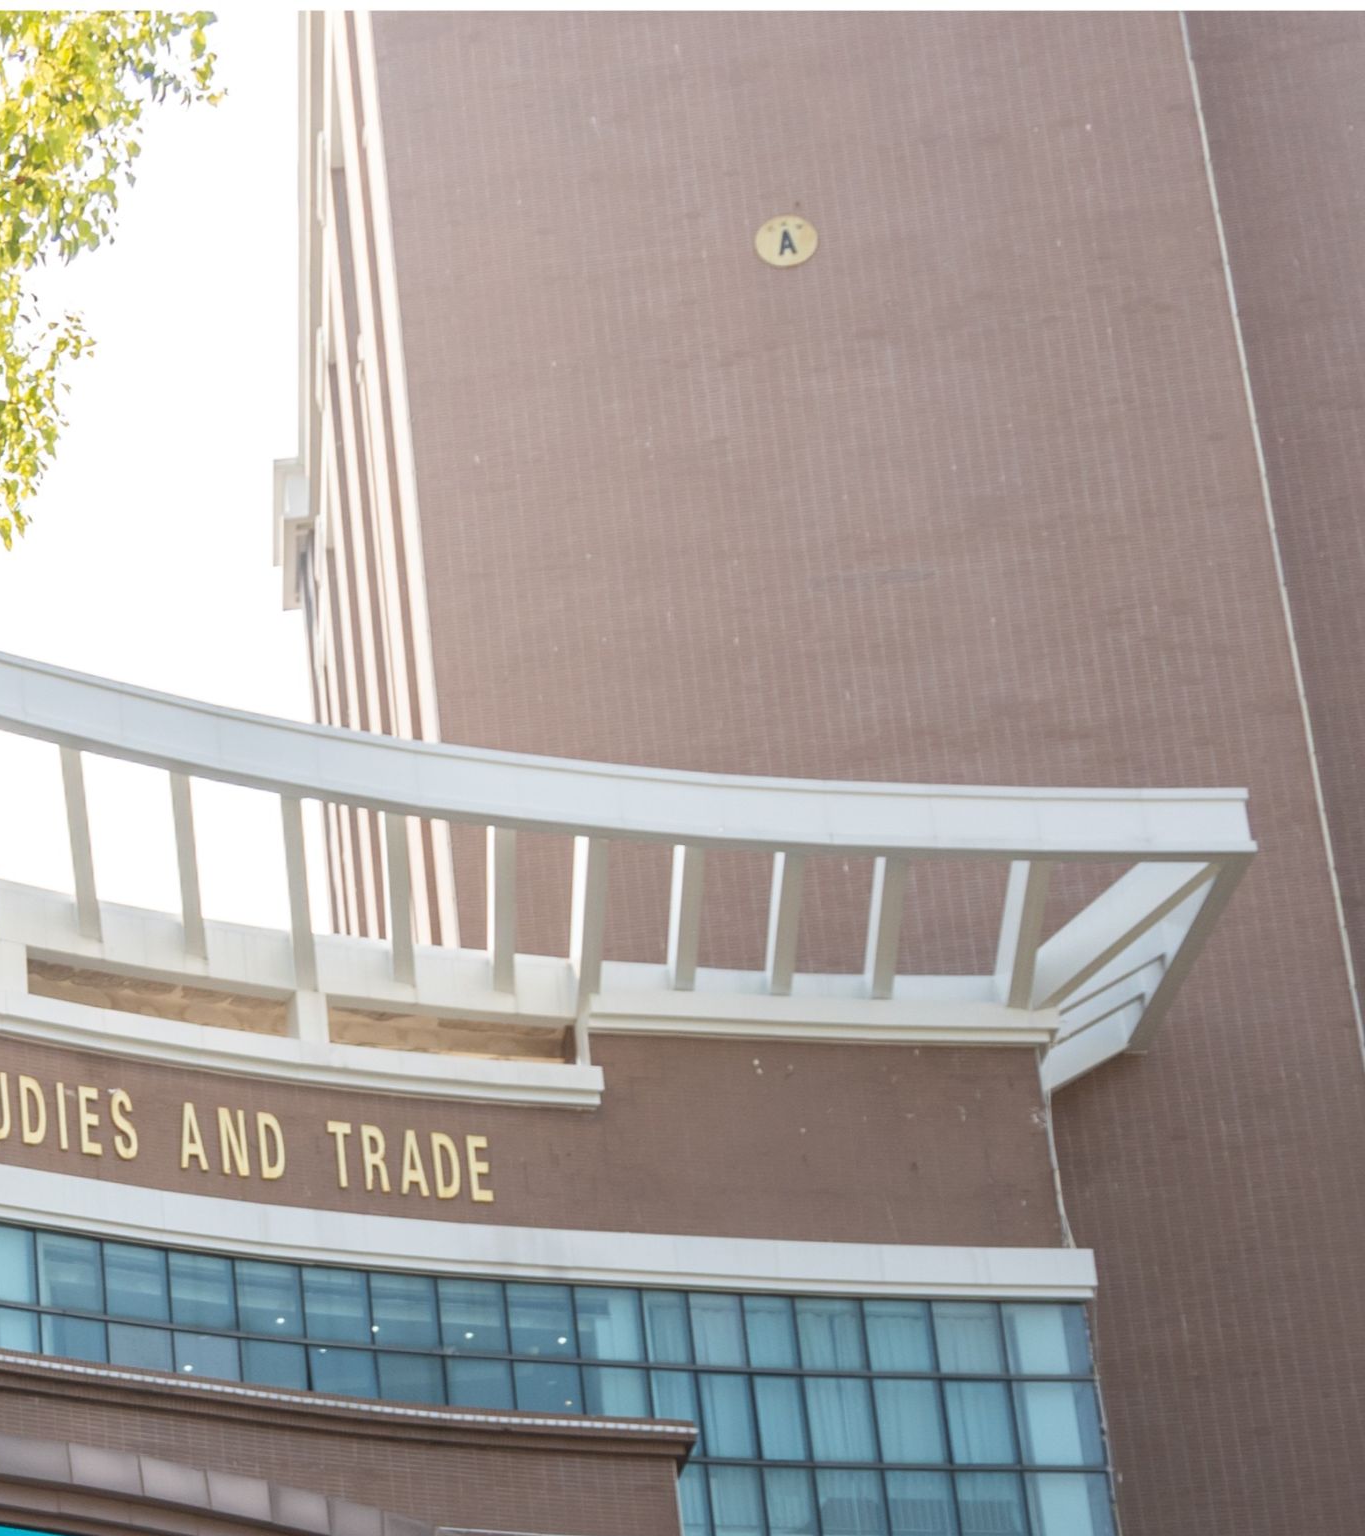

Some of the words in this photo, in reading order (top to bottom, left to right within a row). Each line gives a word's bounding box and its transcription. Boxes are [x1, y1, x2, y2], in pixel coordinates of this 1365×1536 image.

[778, 228, 798, 256] A
[180, 1101, 287, 1181] AND
[327, 1120, 495, 1203] TRADE
